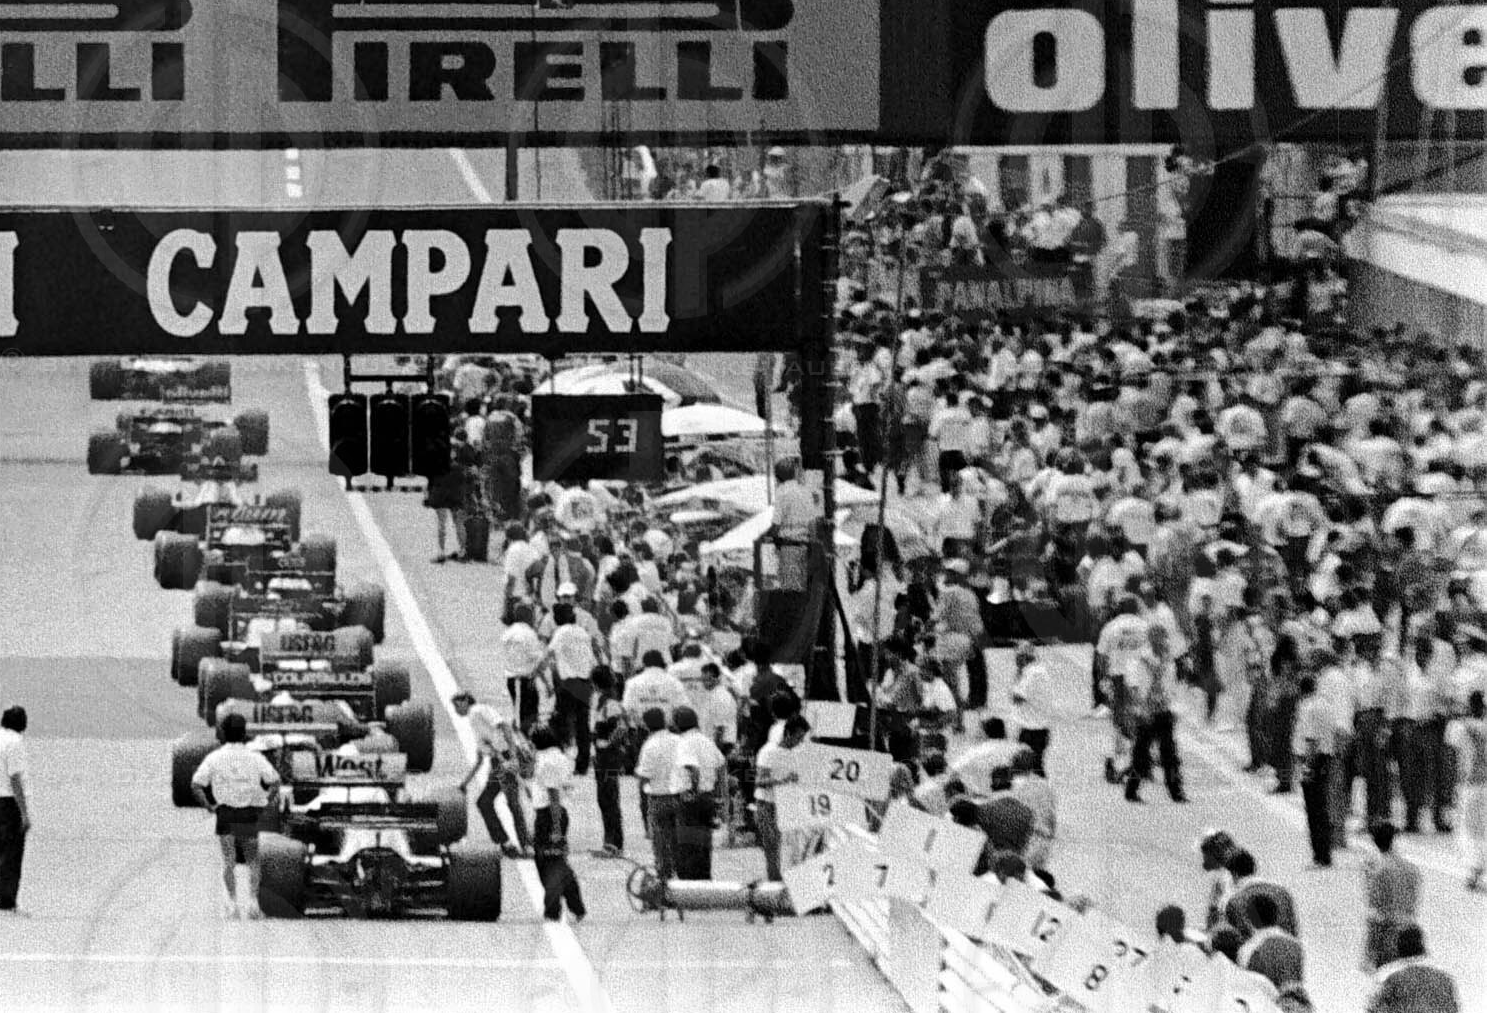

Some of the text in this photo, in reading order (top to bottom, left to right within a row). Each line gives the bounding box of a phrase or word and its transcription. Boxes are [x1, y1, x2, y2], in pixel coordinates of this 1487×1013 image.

[147, 227, 672, 338] CAMPARI
[586, 418, 638, 453] 53
[315, 754, 384, 781] West
[830, 758, 861, 783] 20
[810, 793, 831, 817] 19
[1084, 963, 1109, 992] 8
